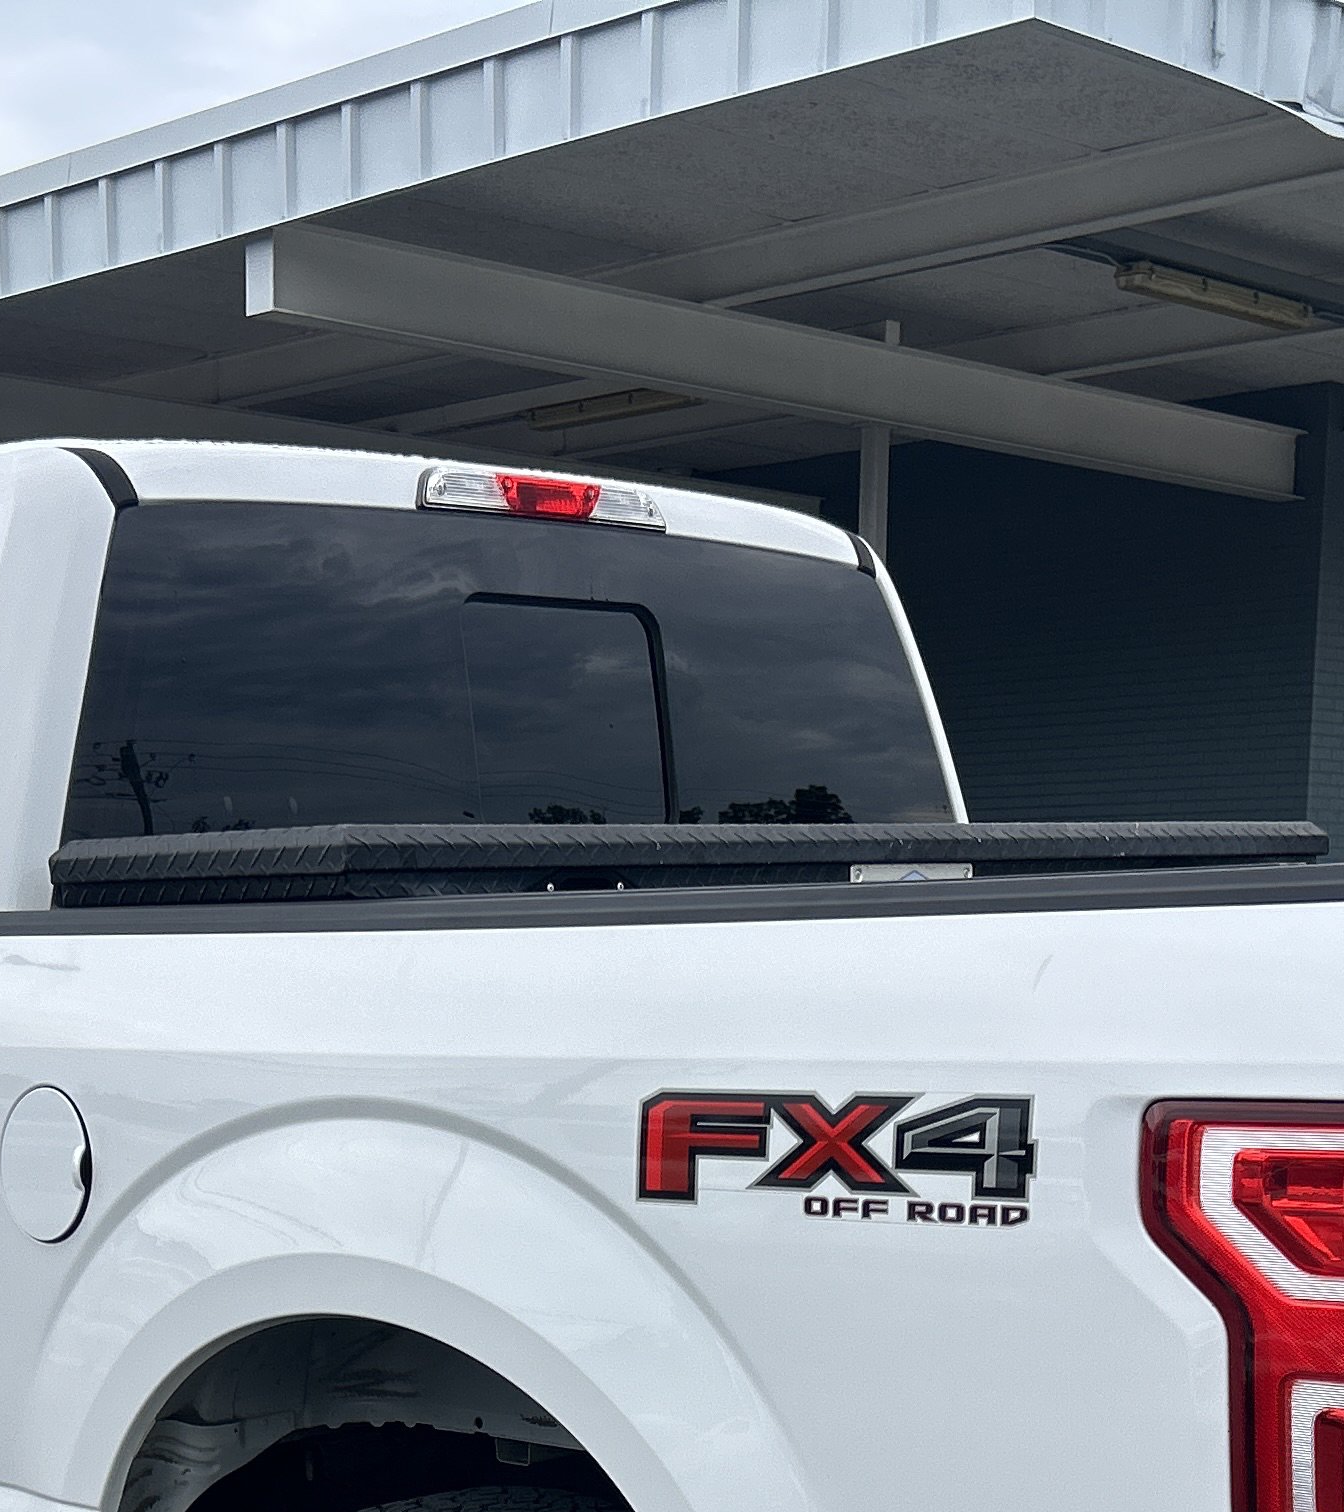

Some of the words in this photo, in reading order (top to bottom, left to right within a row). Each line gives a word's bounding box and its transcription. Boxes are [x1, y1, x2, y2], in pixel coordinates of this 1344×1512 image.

[636, 1088, 1038, 1204] FX4
[803, 1196, 889, 1219] OFF
[907, 1200, 1029, 1226] ROAD
